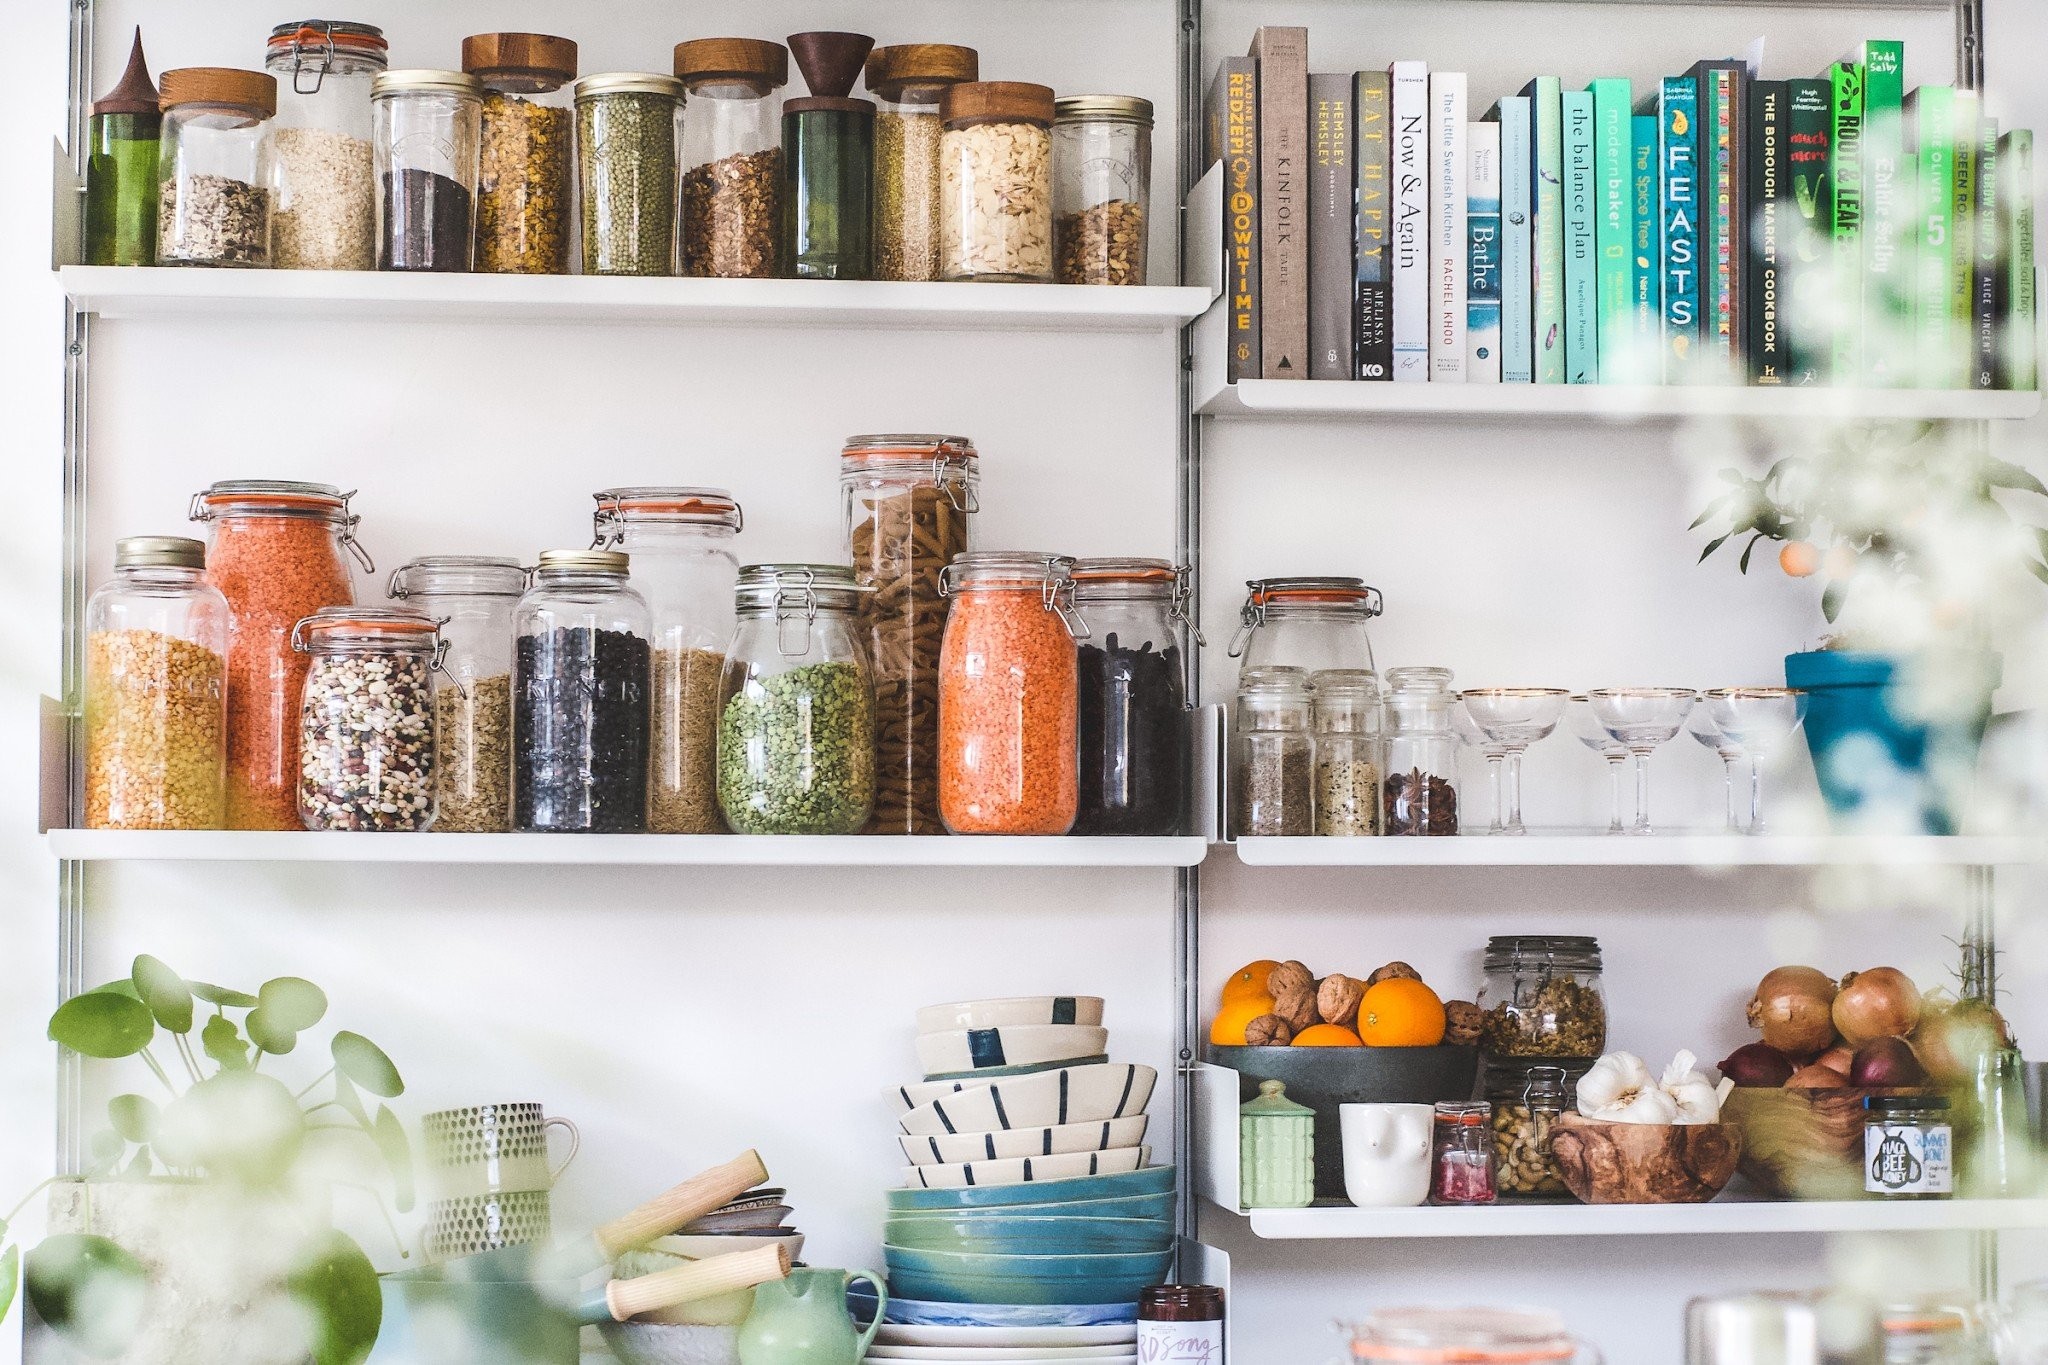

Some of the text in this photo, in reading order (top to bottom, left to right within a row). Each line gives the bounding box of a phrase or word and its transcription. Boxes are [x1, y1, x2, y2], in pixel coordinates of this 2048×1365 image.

[1870, 51, 1895, 62] Todd
[1870, 62, 1897, 75] Selby
[1229, 73, 1245, 155] REDZEPI
[1244, 73, 1253, 156] NADINE LEVY
[1801, 89, 1818, 97] Hugh
[1318, 101, 1329, 166] HEMSLEY
[1333, 101, 1344, 166] HEMSLEY
[1790, 130, 1828, 147] much
[1790, 150, 1827, 162] more
[1957, 140, 1968, 189] GREEN
[1983, 127, 1996, 153] HOW
[1983, 156, 1996, 170] TO
[1365, 88, 1383, 262] EAT HAPPY
[1396, 115, 1422, 270] Now & Again
[1443, 93, 1454, 246] The Little Swedish Kitchen
[1571, 108, 1590, 259] the balance plan
[1636, 145, 1651, 249] The Spice Tree
[1837, 115, 1860, 231] ROOT & LEAF
[1930, 152, 1942, 203] OLIVER
[1983, 174, 1996, 207] GROW
[1278, 158, 1291, 245] KINFOLK
[1765, 93, 1776, 353] THE BOROUGH MARKET COOKBOOK
[1927, 214, 1945, 246] 5
[1473, 227, 1495, 289] Bathe
[1669, 146, 1692, 325] FEASTS
[1280, 252, 1288, 286] TABLE
[1956, 271, 1966, 295] TIN
[1363, 288, 1372, 346] HEMSLEY
[1374, 290, 1384, 345] MELISSA
[1443, 258, 1454, 346] RACHEL KHOO
[1577, 279, 1586, 350] Angelique Panagos
[1981, 277, 1992, 354] ALICE VINCENT
[1882, 1154, 1907, 1171] BEE
